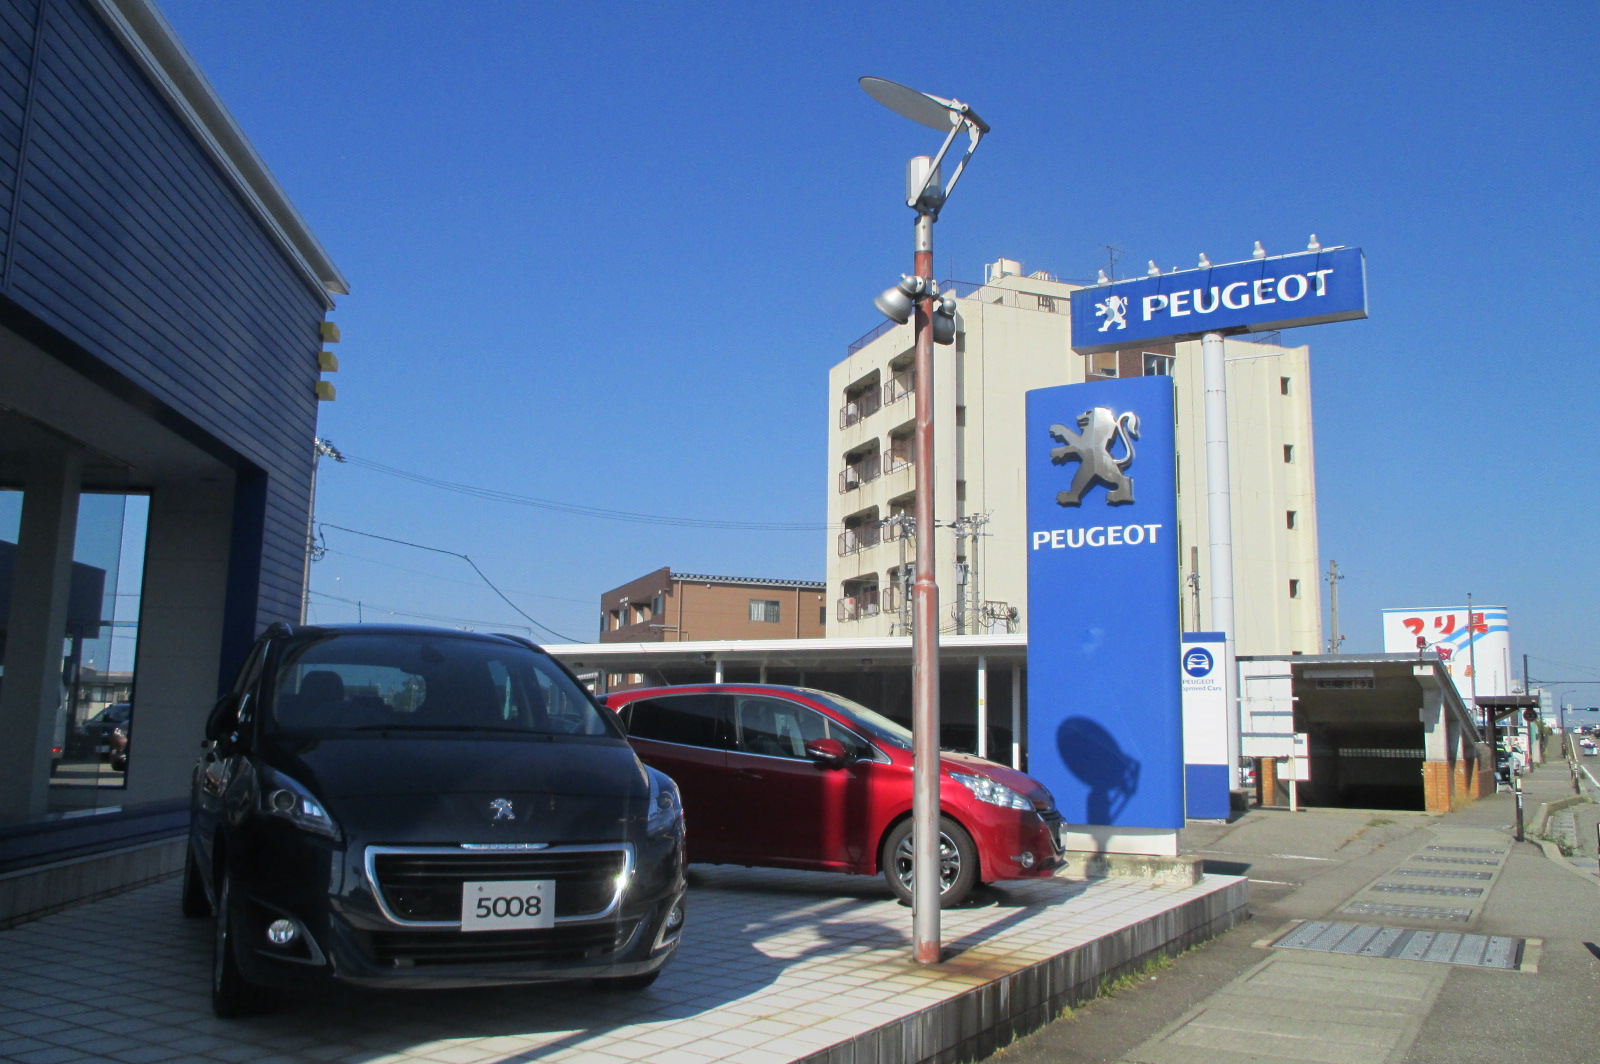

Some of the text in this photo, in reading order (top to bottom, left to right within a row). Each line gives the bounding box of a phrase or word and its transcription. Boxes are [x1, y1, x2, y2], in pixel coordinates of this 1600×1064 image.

[1142, 269, 1333, 321] PEUGEOT
[1033, 523, 1162, 550] PEUGEOT
[476, 895, 542, 918] 5008
